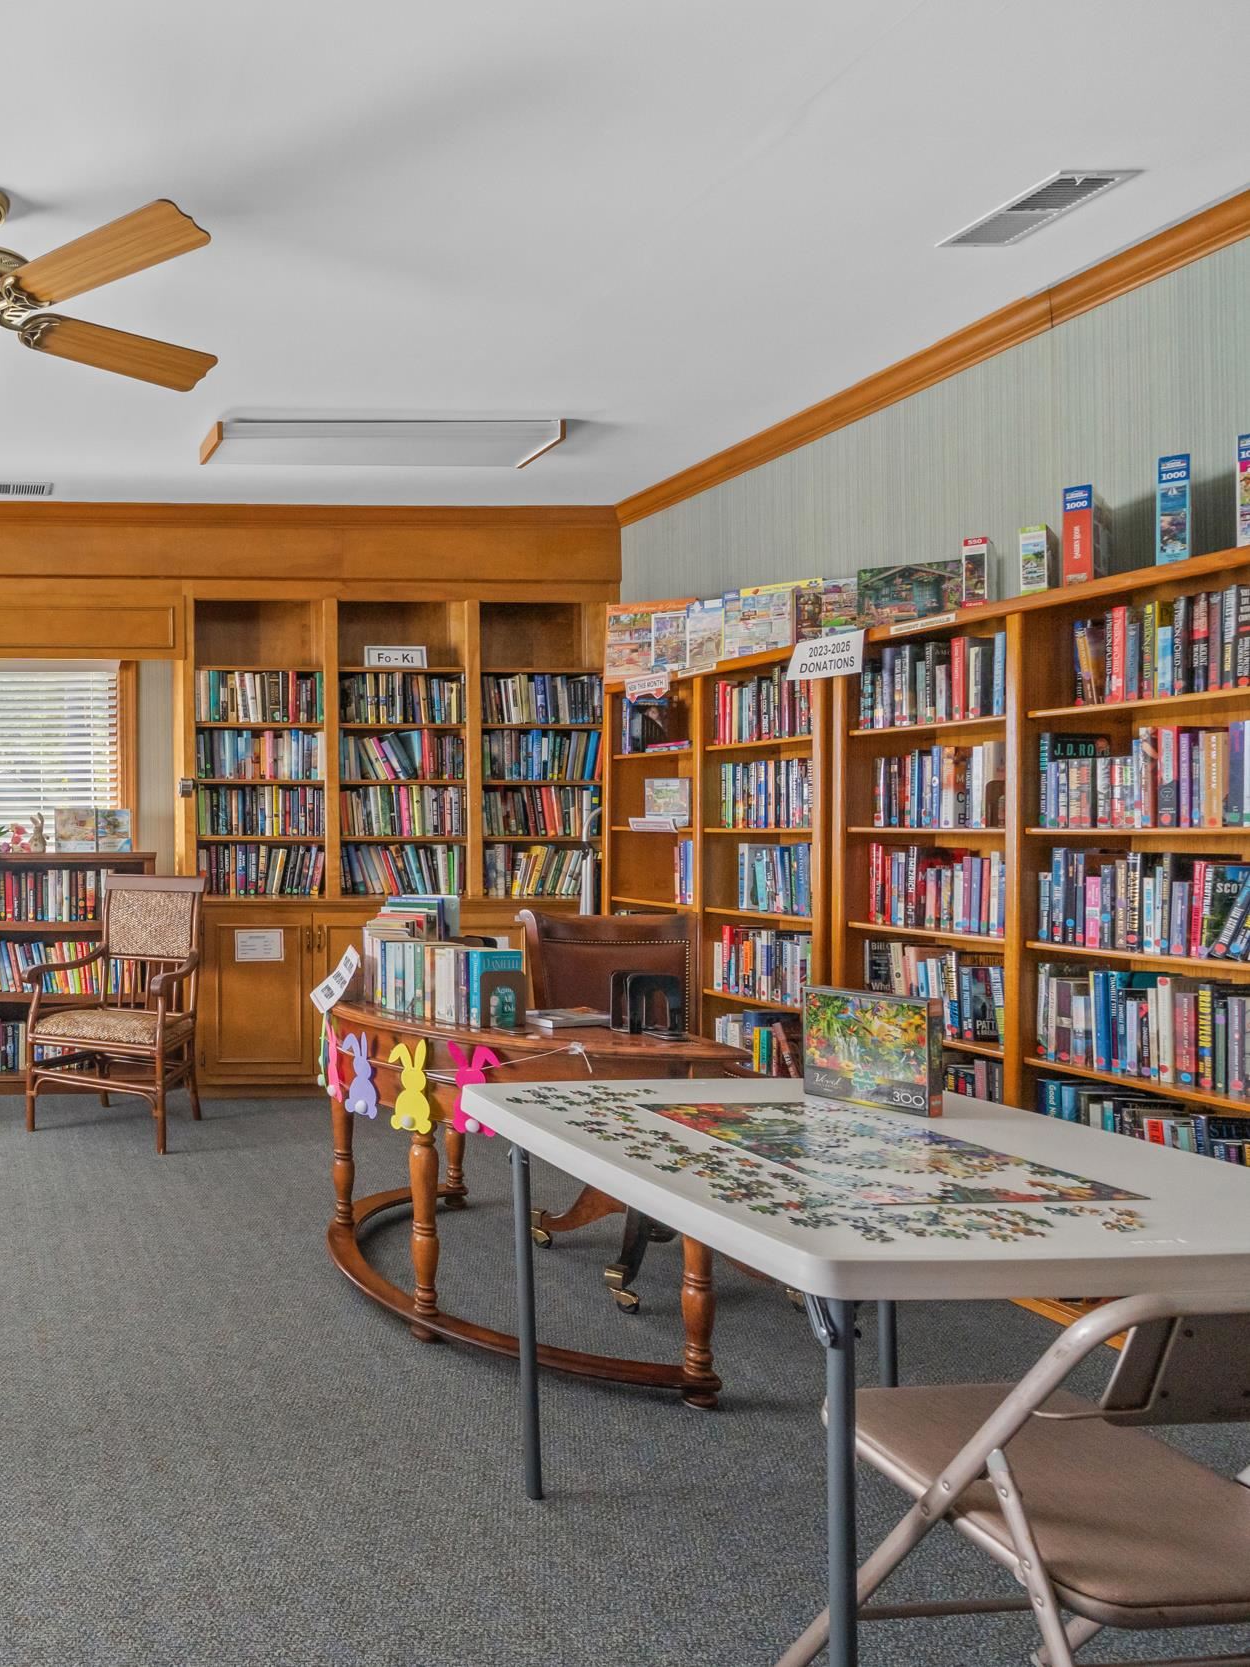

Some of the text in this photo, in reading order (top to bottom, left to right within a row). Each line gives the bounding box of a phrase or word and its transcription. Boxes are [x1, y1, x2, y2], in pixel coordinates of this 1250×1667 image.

[1161, 470, 1186, 480] 1000
[1066, 500, 1088, 510] 1000
[1199, 643, 1208, 666] MOUNT
[799, 656, 855, 674] DONATIONS
[638, 682, 647, 690] THIS
[647, 679, 664, 689] MONTH
[1181, 737, 1189, 762] JENEVA
[1202, 867, 1214, 916] LISA SCOTTOLINE
[1216, 882, 1242, 894] SCOT
[1231, 906, 1245, 920] LISA
[871, 942, 885, 951] Bill
[483, 958, 520, 970] DANIELLE
[962, 975, 971, 1018] JAMES PATTERSON
[1109, 976, 1117, 1001] DANIELLE
[976, 1020, 996, 1030] PATT
[1198, 989, 1212, 1048] BRAD TAYLOR
[892, 1090, 925, 1106] 300
[1048, 1085, 1056, 1105] Good
